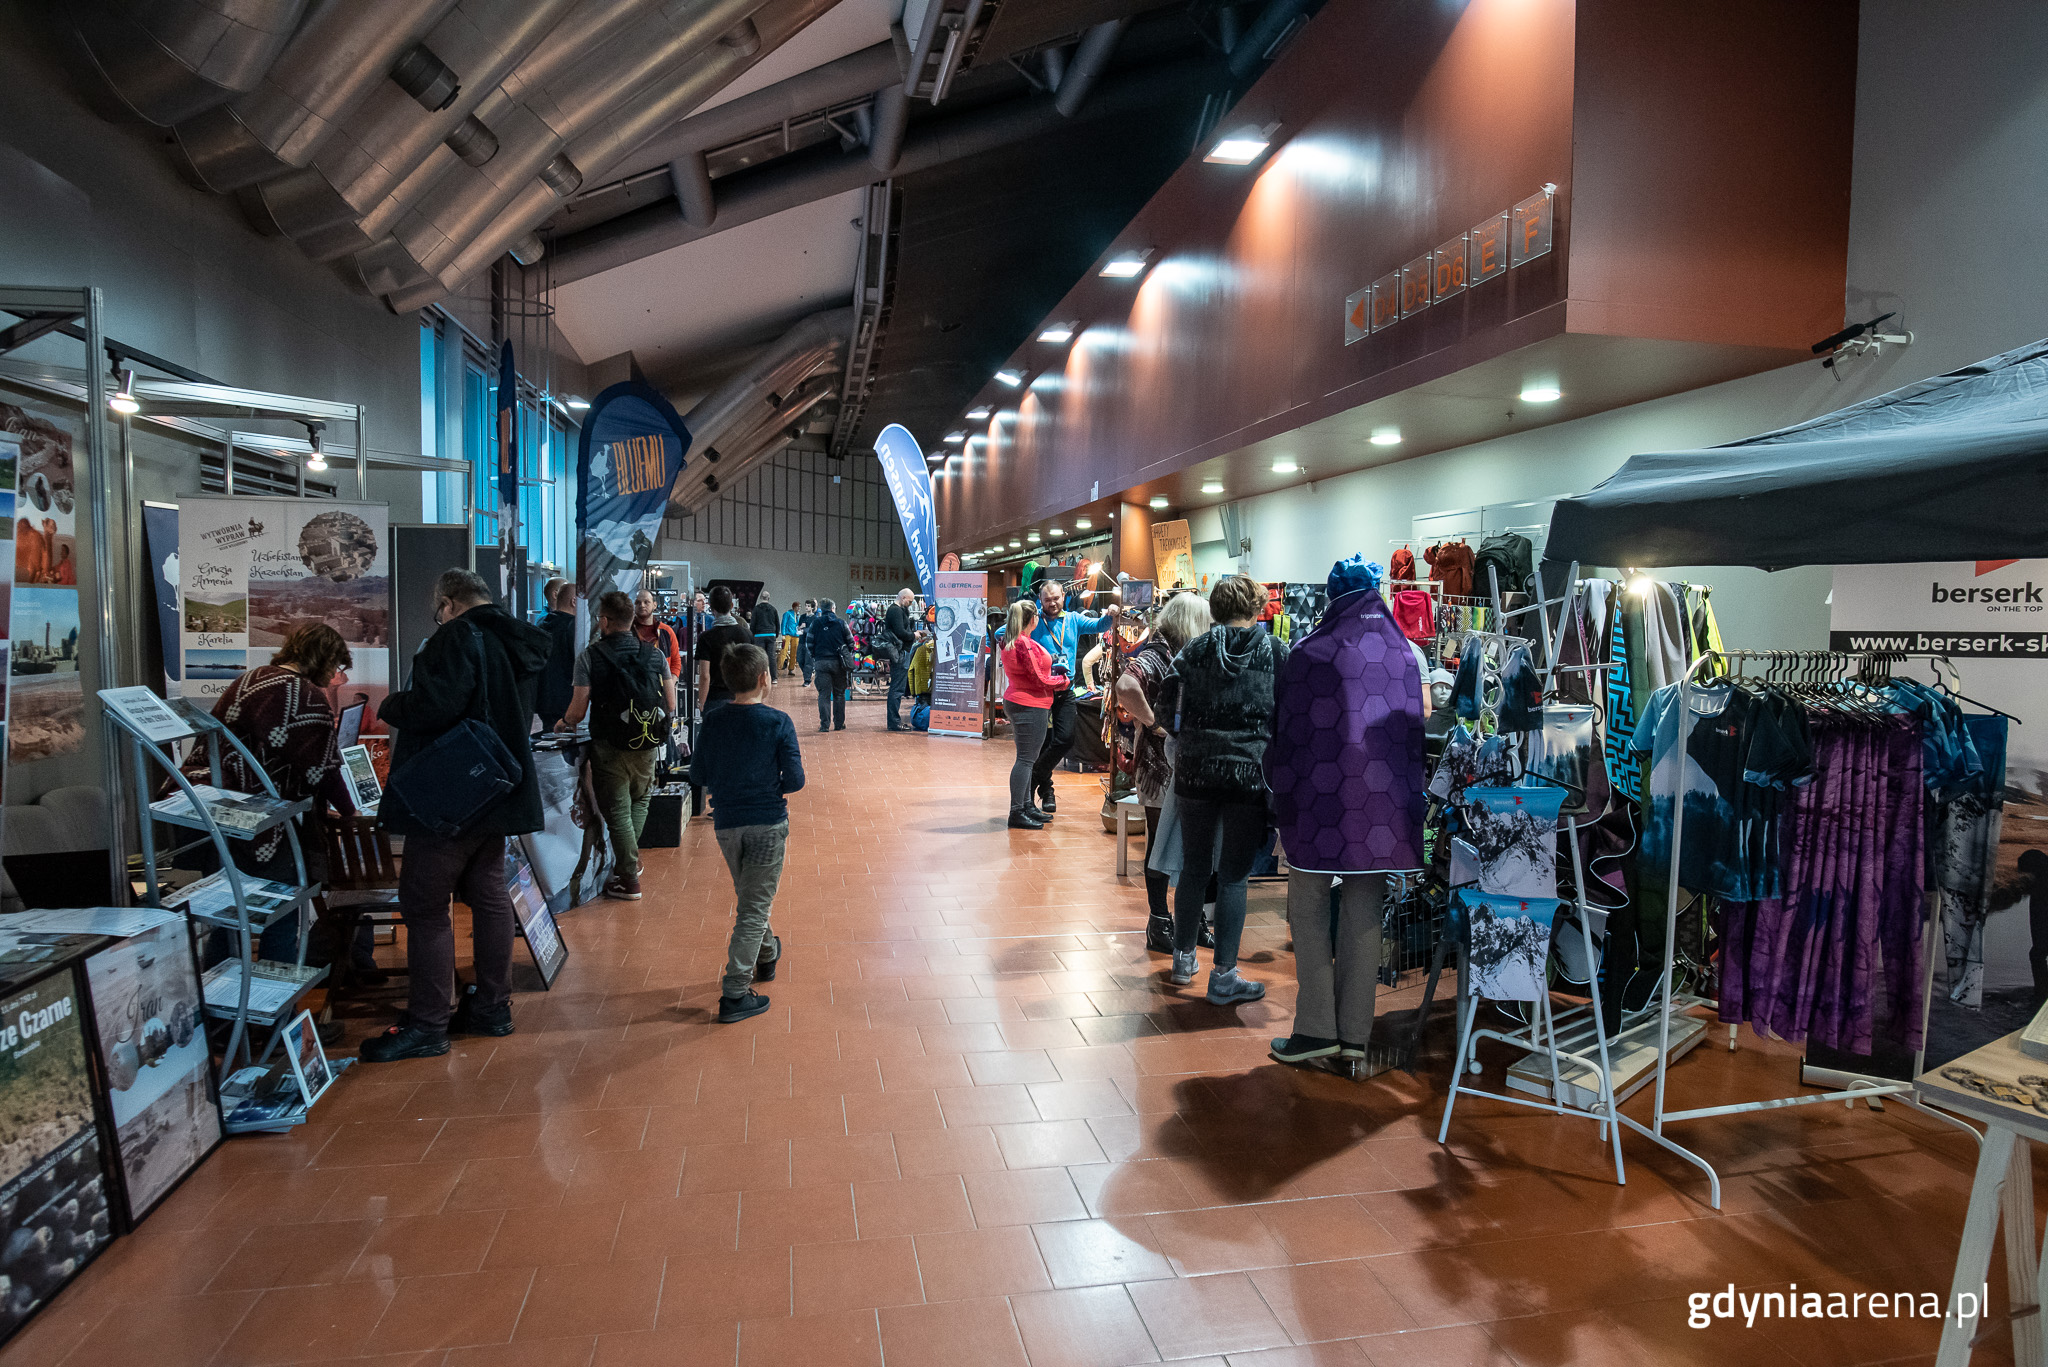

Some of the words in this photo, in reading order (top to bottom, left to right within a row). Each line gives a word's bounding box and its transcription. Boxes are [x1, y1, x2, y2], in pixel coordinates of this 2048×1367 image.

[1404, 274, 1428, 311] D5
[1437, 256, 1463, 295] D6
[1481, 239, 1495, 274] E
[1524, 216, 1540, 253] F
[201, 523, 243, 540] WYTWÓRNIA
[215, 531, 245, 544] WYPRAW
[251, 549, 301, 561] Uzbekistan
[198, 562, 232, 578] Gruzja
[250, 565, 303, 579] Kazachstan
[192, 575, 233, 590] Armenia
[1931, 582, 2043, 603] berserk
[1987, 605, 2000, 613] ON
[198, 634, 233, 647] Karelia
[201, 684, 227, 694] Odess
[1527, 705, 1544, 713] berse
[19, 996, 72, 1039] Czarne
